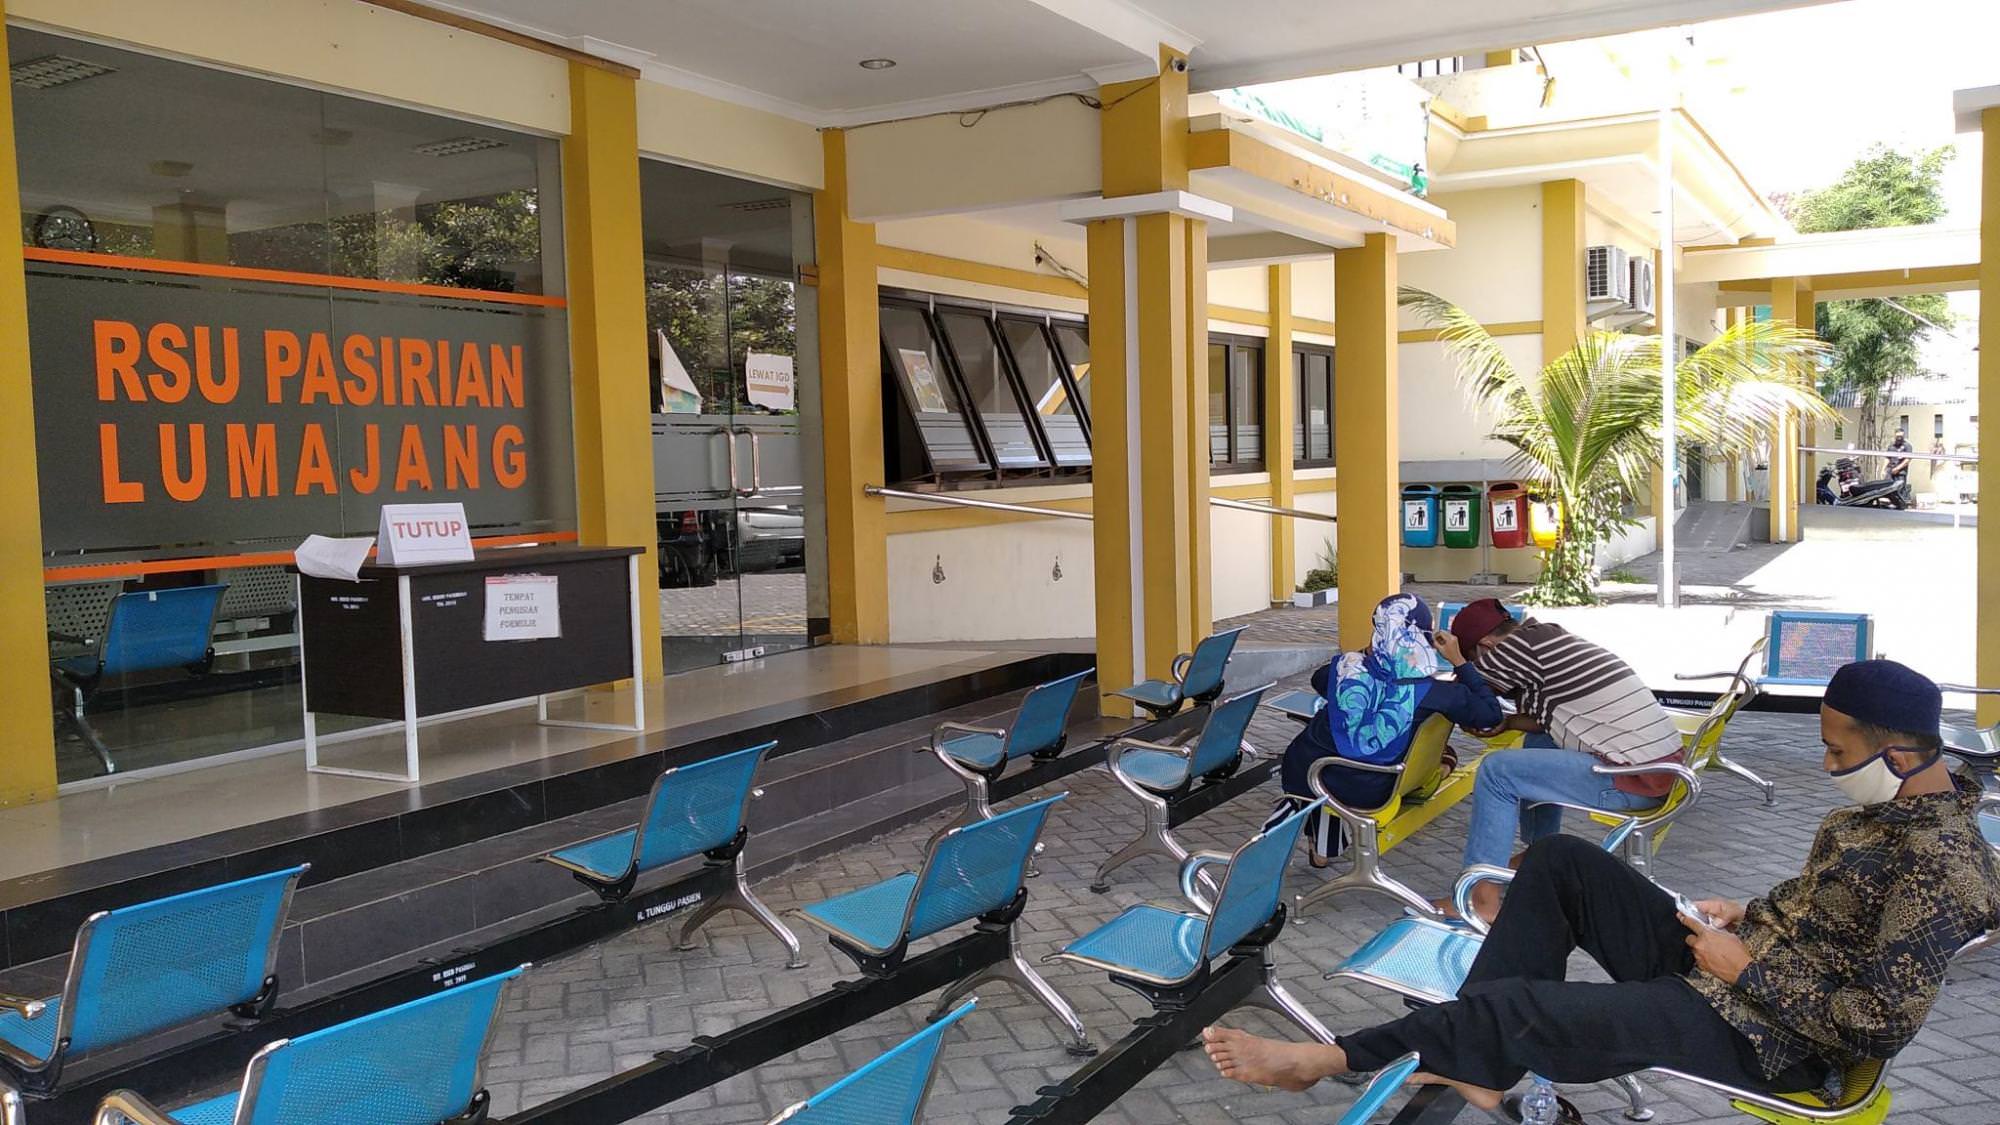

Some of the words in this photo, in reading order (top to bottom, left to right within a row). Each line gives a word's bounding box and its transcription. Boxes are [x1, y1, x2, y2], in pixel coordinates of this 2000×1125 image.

[93, 320, 240, 404] RSU
[264, 329, 525, 408] PASIRIAN
[749, 368, 774, 380] LEWAT
[776, 371, 790, 382] IGD
[100, 423, 527, 504] LUMAJANG
[393, 520, 462, 538] TUTUP
[503, 592, 535, 601] TEMPAT
[645, 900, 676, 918] TUNGGU
[677, 891, 701, 908] PASIEN
